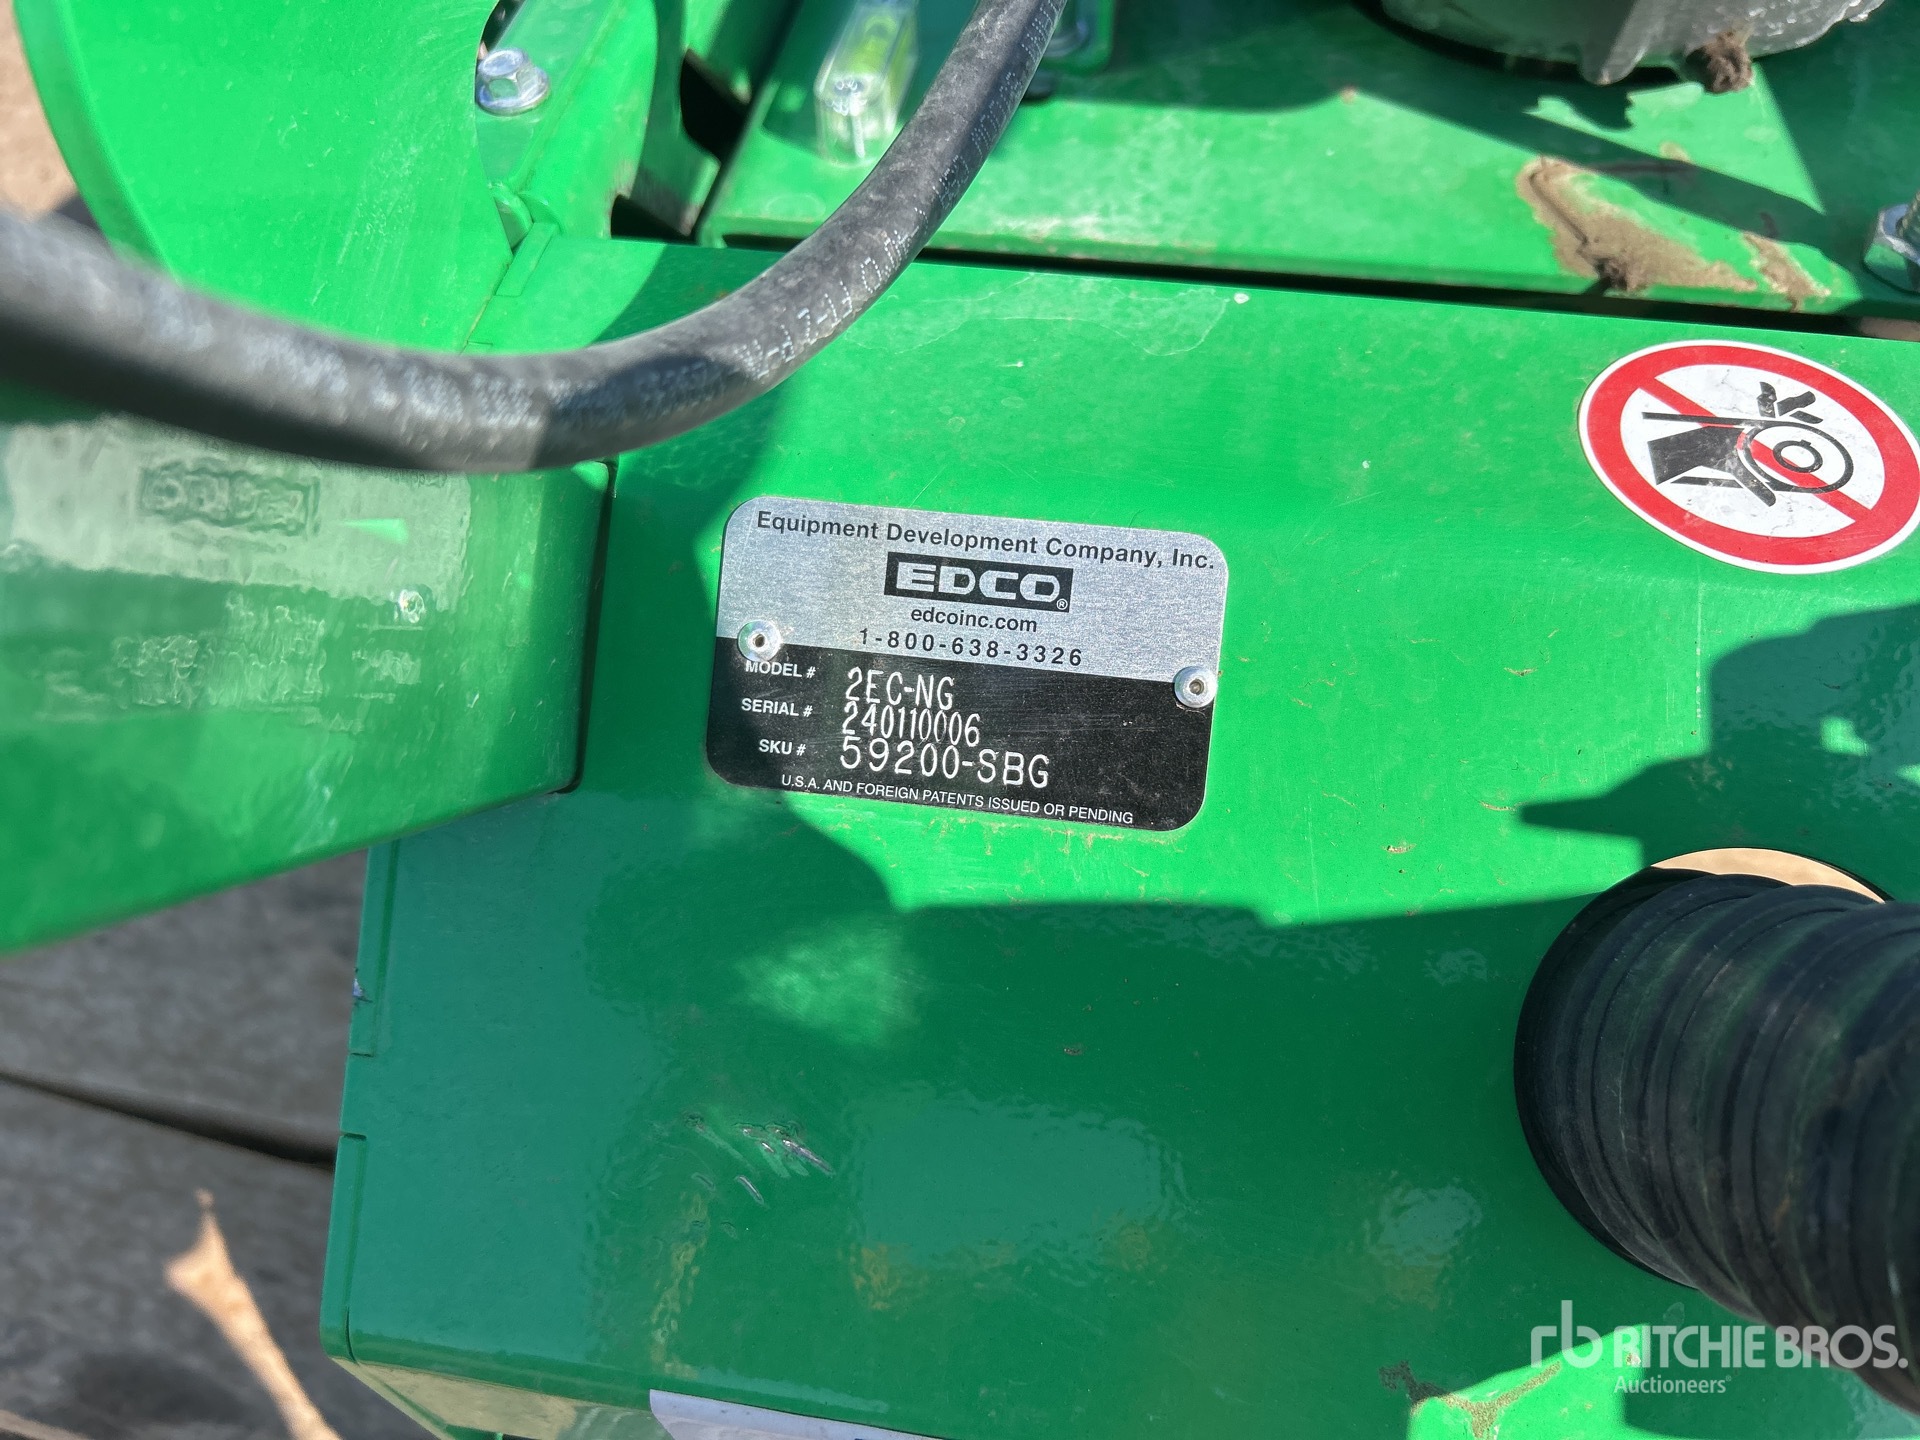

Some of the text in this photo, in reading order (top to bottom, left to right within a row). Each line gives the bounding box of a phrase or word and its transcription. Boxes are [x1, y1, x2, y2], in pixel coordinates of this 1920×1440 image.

[757, 510, 1215, 570] Equipment Development Company, Inc.
[911, 607, 1037, 633] edcoinc.com
[859, 627, 1082, 667] 1-800-638-3326
[745, 661, 955, 711] MODEL # 2EC-NG
[741, 698, 981, 747] SERIAL # 240110006
[758, 737, 1049, 789] SKU # 59200-SBG
[781, 774, 1134, 825] U.S.A. AND FOREIGN PATENTS ISSUED OR PENDING
